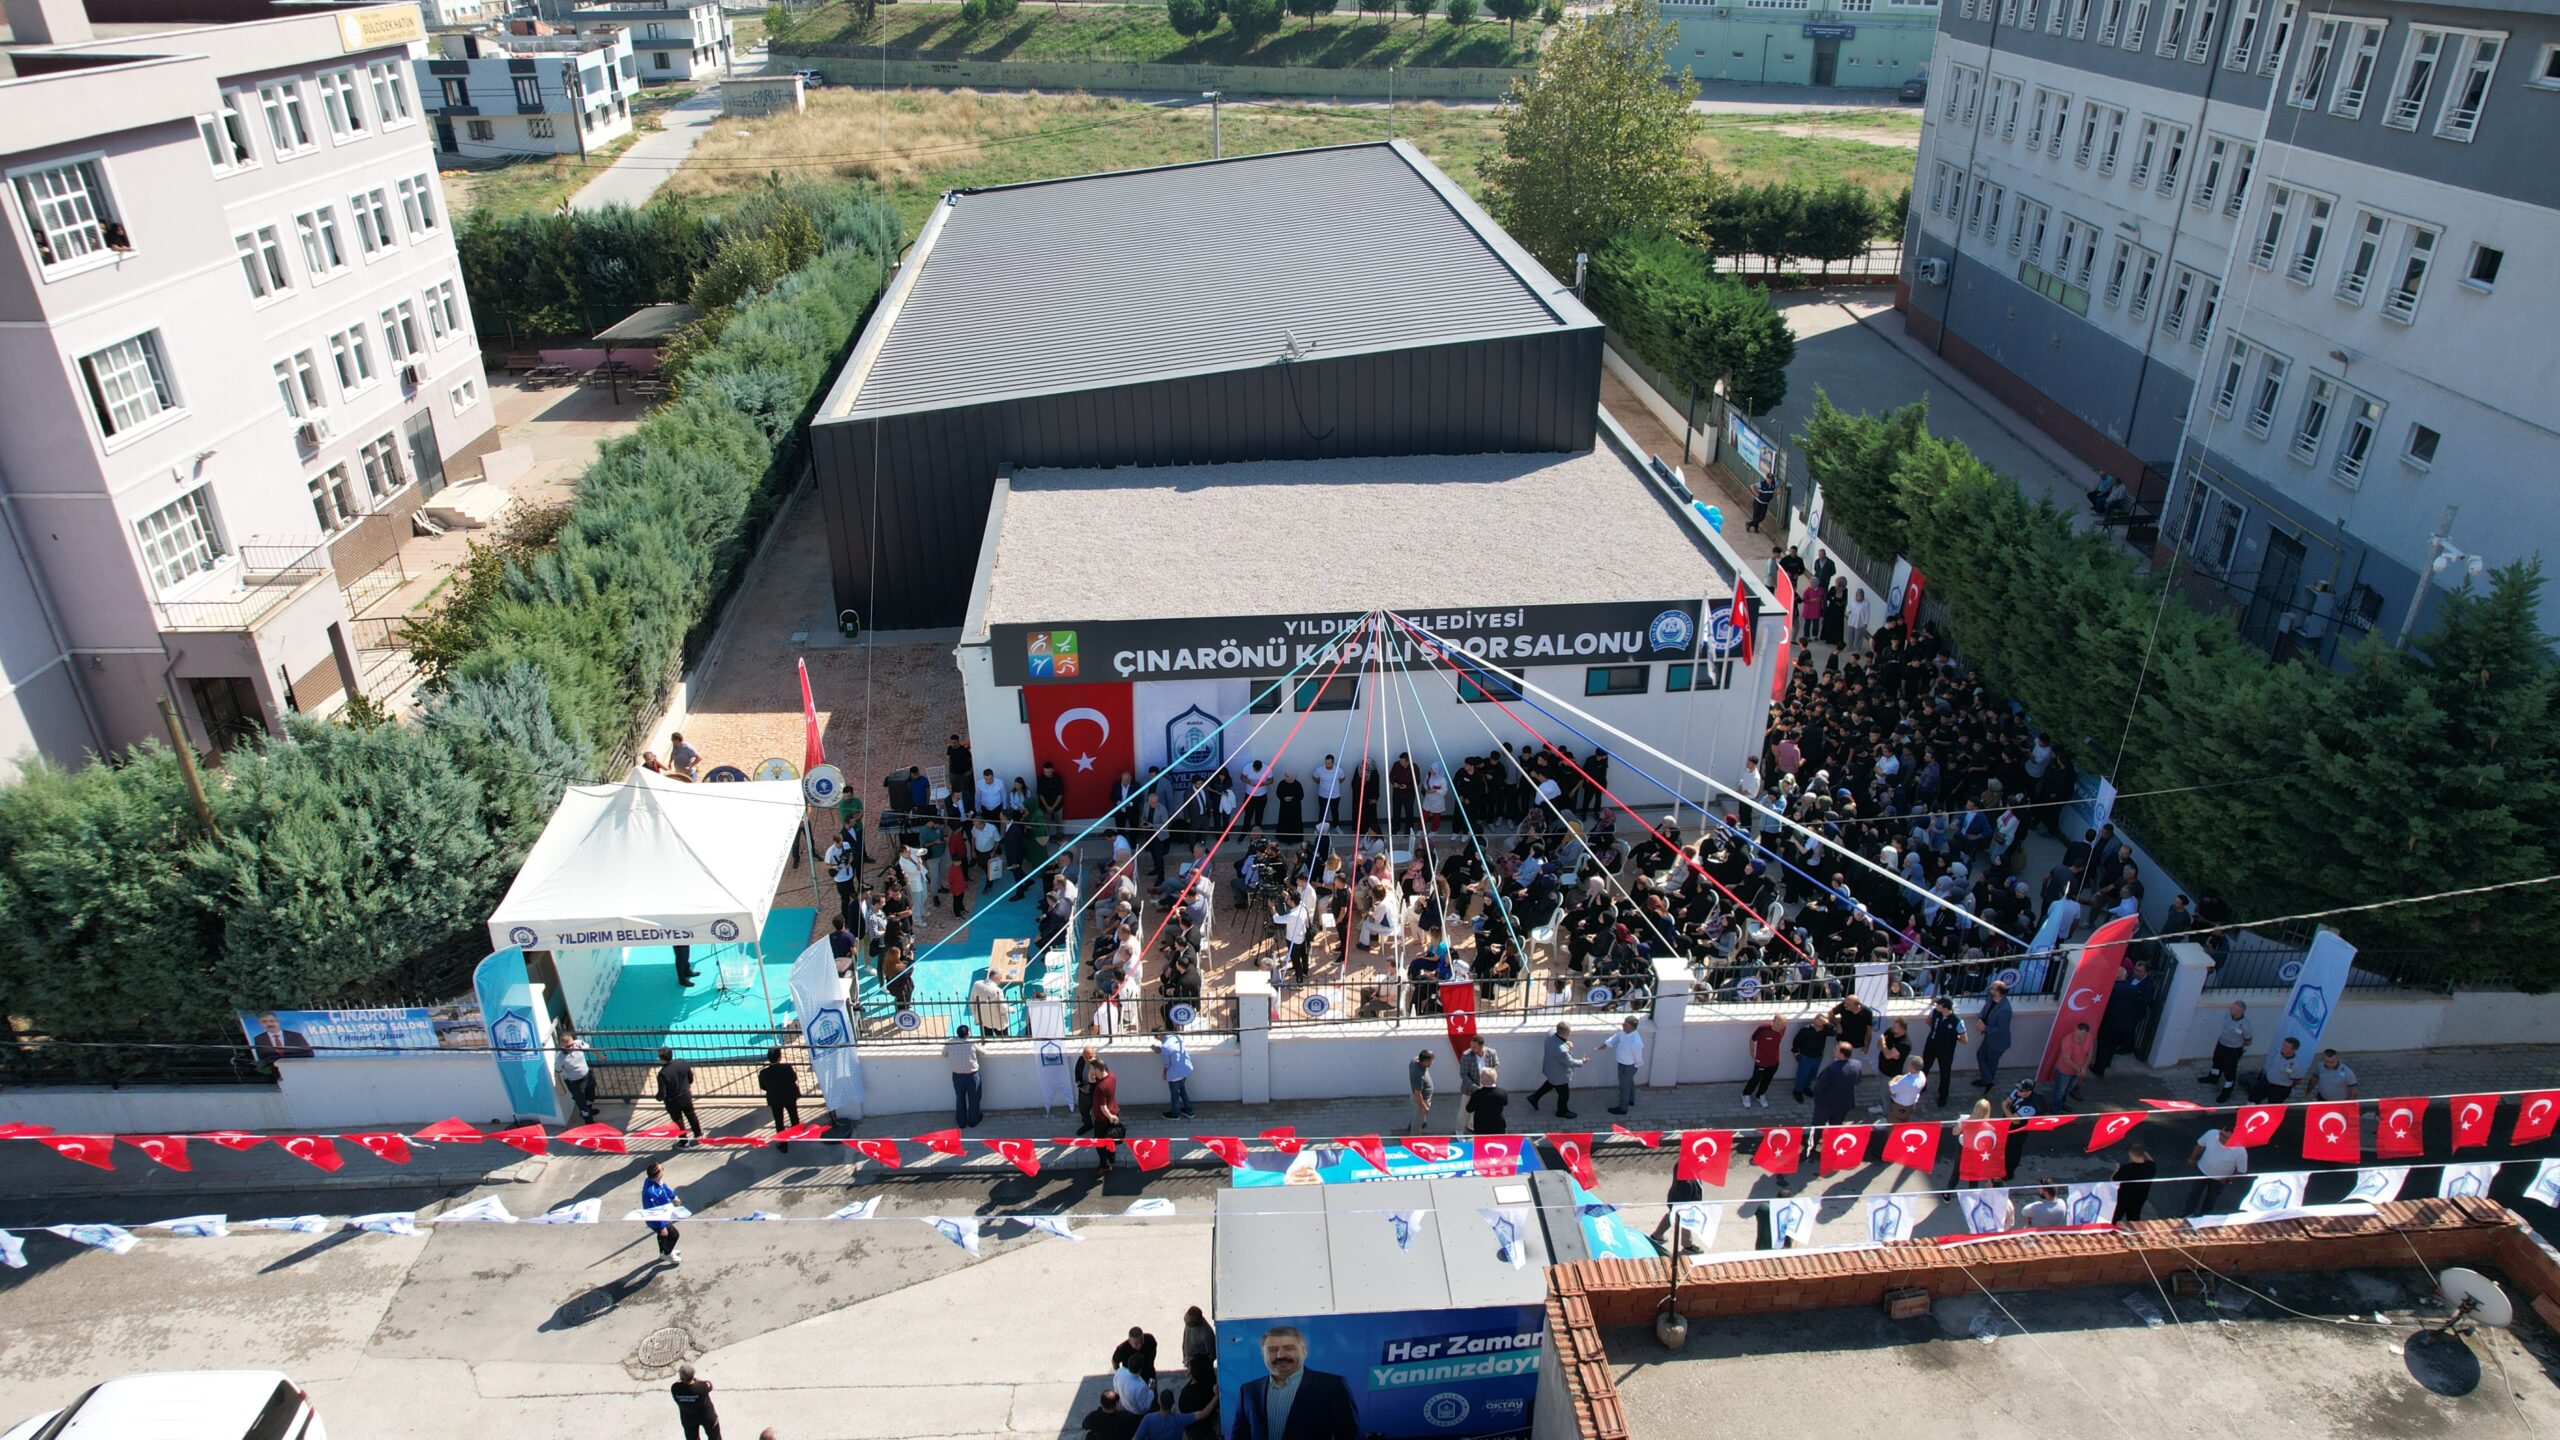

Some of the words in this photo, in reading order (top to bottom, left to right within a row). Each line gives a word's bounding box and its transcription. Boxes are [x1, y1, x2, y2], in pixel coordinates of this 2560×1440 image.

[1284, 617, 1385, 636] YILDIRIM
[1393, 608, 1524, 632] BELEDİYESİ
[1113, 637, 1287, 678] ÇINARÖNÜ
[1295, 641, 1412, 667] KAPALI
[1420, 636, 1509, 662] SPOR
[1512, 631, 1644, 657] SALONU
[556, 930, 613, 945] YILDIRIM
[616, 928, 694, 941] BELEDİYESİ
[307, 1021, 355, 1036] KAPALI
[358, 1022, 387, 1034] SPOR
[389, 1020, 429, 1032] SALONU
[1388, 1342, 1441, 1362] Her
[1447, 1331, 1544, 1355] Zaman
[1373, 1355, 1540, 1386] Yanınızdayı
